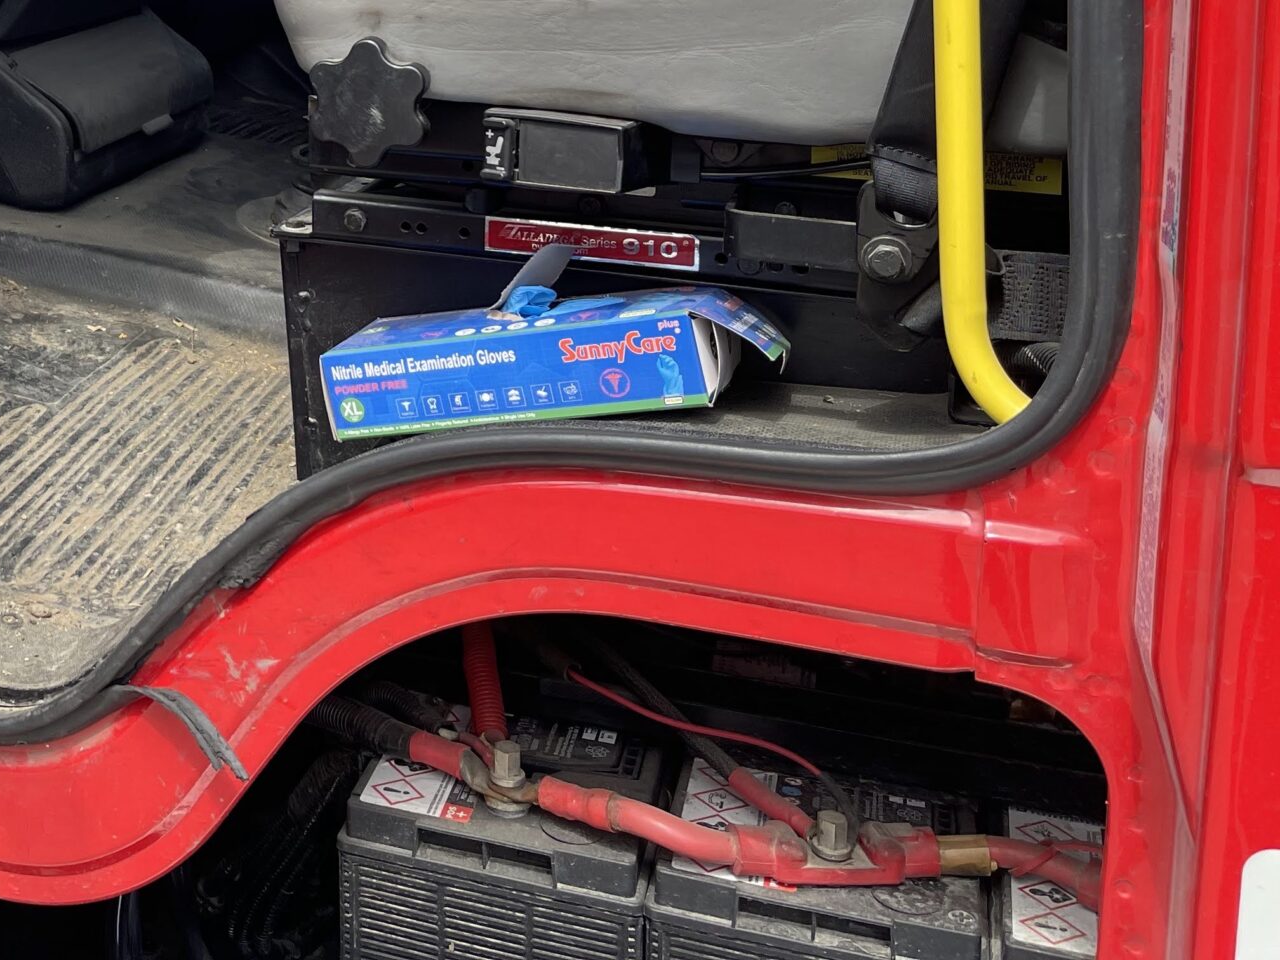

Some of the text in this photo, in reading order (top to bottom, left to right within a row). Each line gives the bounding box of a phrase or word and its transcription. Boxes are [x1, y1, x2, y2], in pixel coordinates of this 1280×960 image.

[581, 235, 617, 250] Series
[622, 237, 679, 259] 910
[657, 319, 680, 332] plus
[559, 330, 677, 364] SunnyCare
[331, 348, 517, 381] Nitrile Medical Examination Gloves
[334, 378, 408, 395] POWDER FREE
[341, 401, 361, 417] XL
